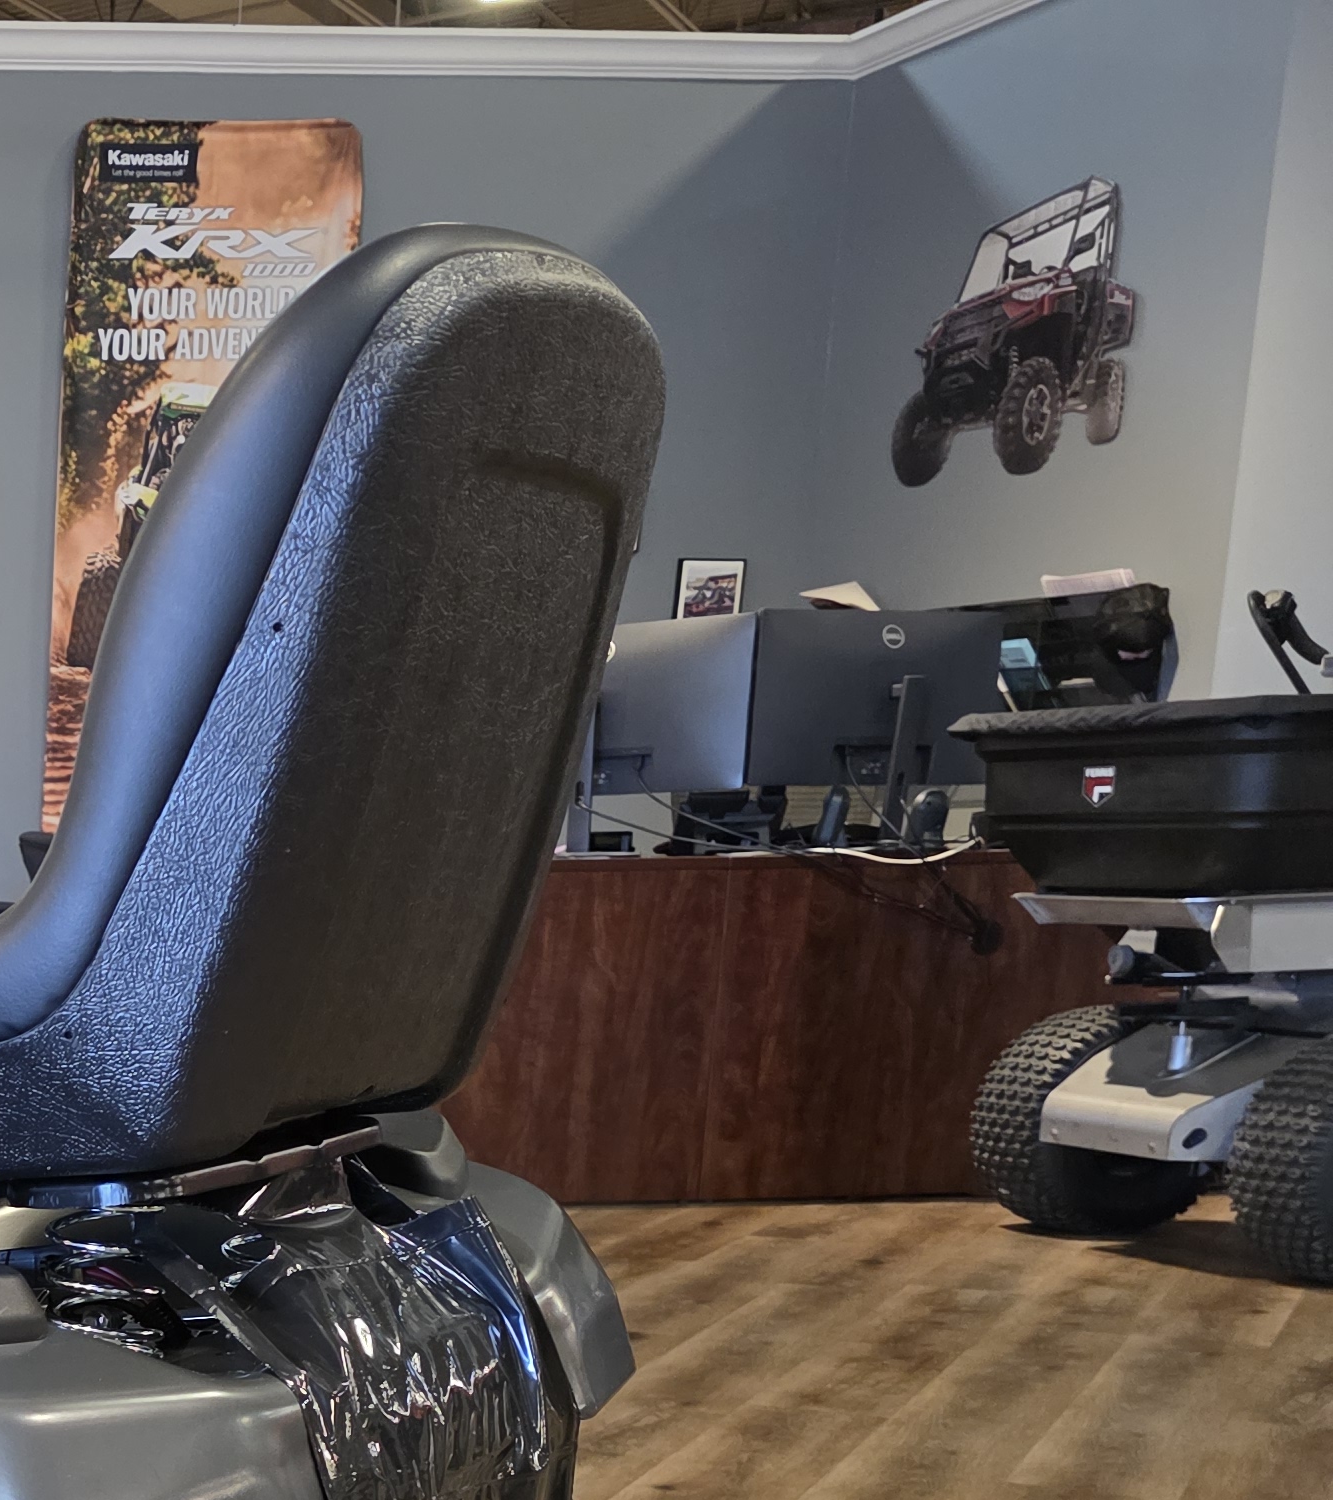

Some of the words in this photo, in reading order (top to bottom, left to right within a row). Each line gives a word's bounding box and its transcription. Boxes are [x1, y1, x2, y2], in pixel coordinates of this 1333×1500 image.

[107, 149, 190, 167] Kawasaki
[135, 170, 153, 179] good
[126, 202, 236, 224] TERYX
[108, 224, 322, 260] KRX
[242, 262, 316, 278] 1000
[127, 287, 196, 321] YOUR
[98, 328, 166, 362] YOUR
[175, 327, 265, 360] ADVEN
